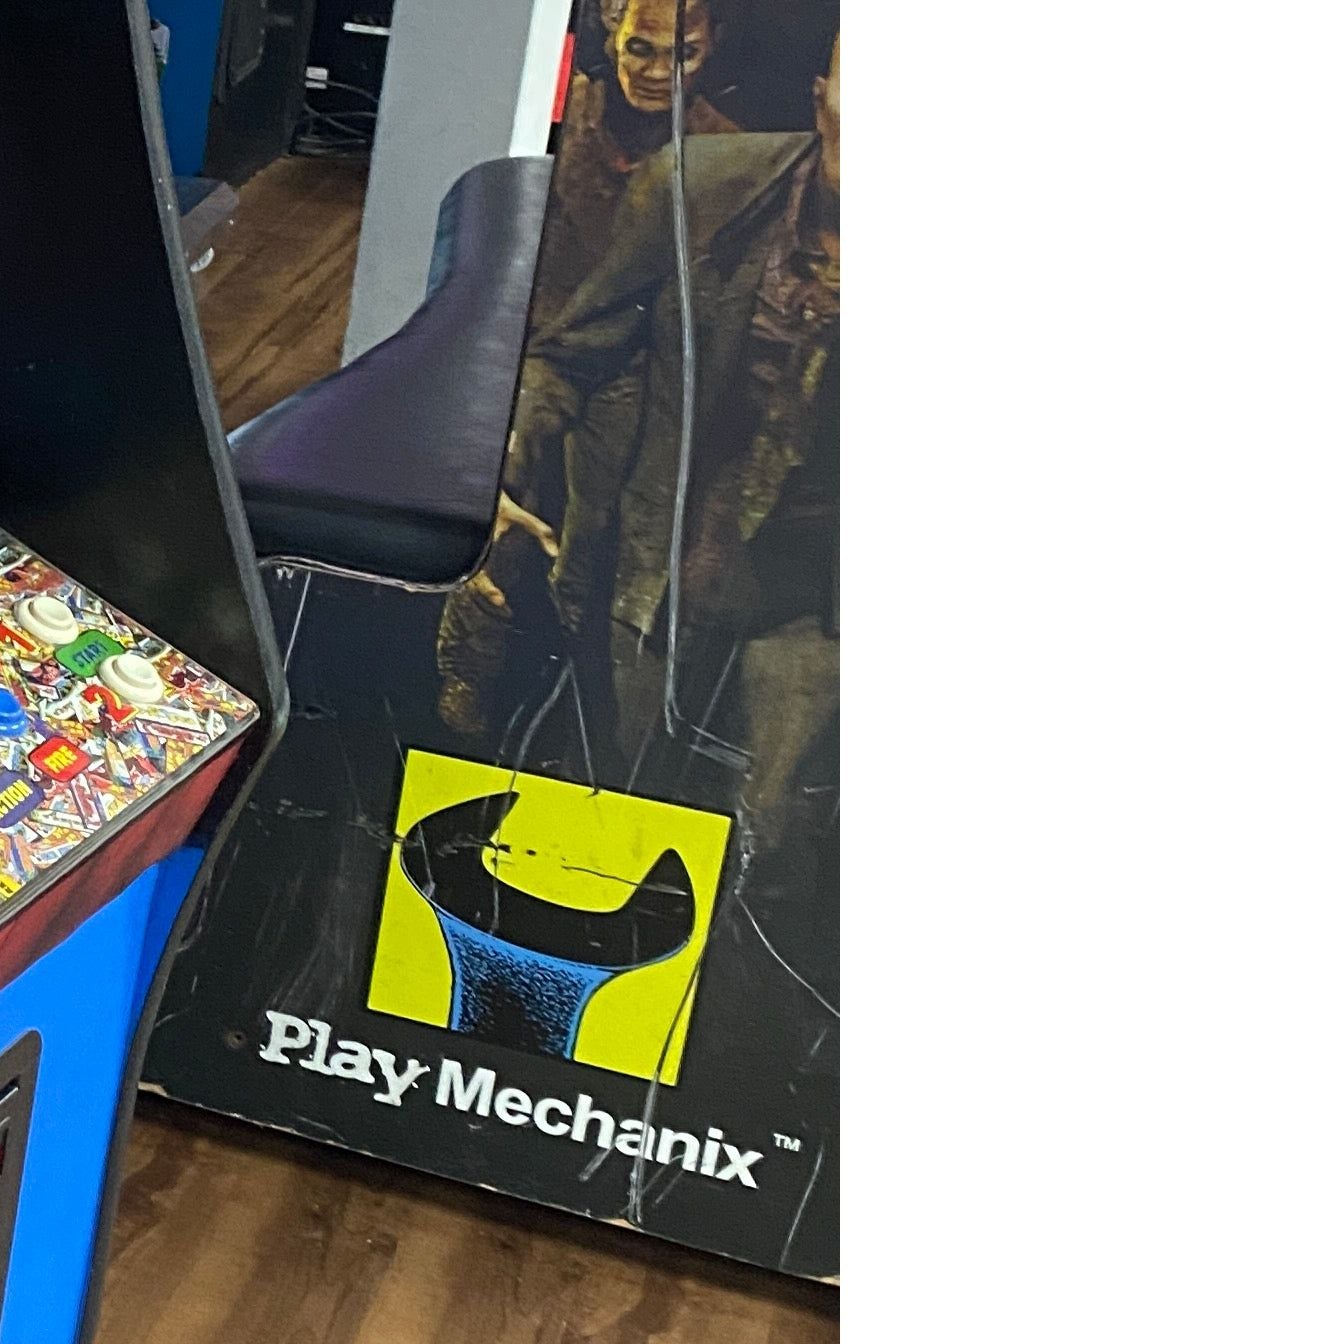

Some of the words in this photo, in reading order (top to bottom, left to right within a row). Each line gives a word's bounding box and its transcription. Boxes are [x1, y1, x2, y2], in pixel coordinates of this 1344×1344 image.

[73, 640, 109, 668] START
[80, 684, 136, 723] 2
[43, 745, 78, 774] FIRE
[259, 1010, 430, 1106] Play
[435, 1058, 764, 1188] Mechanix
